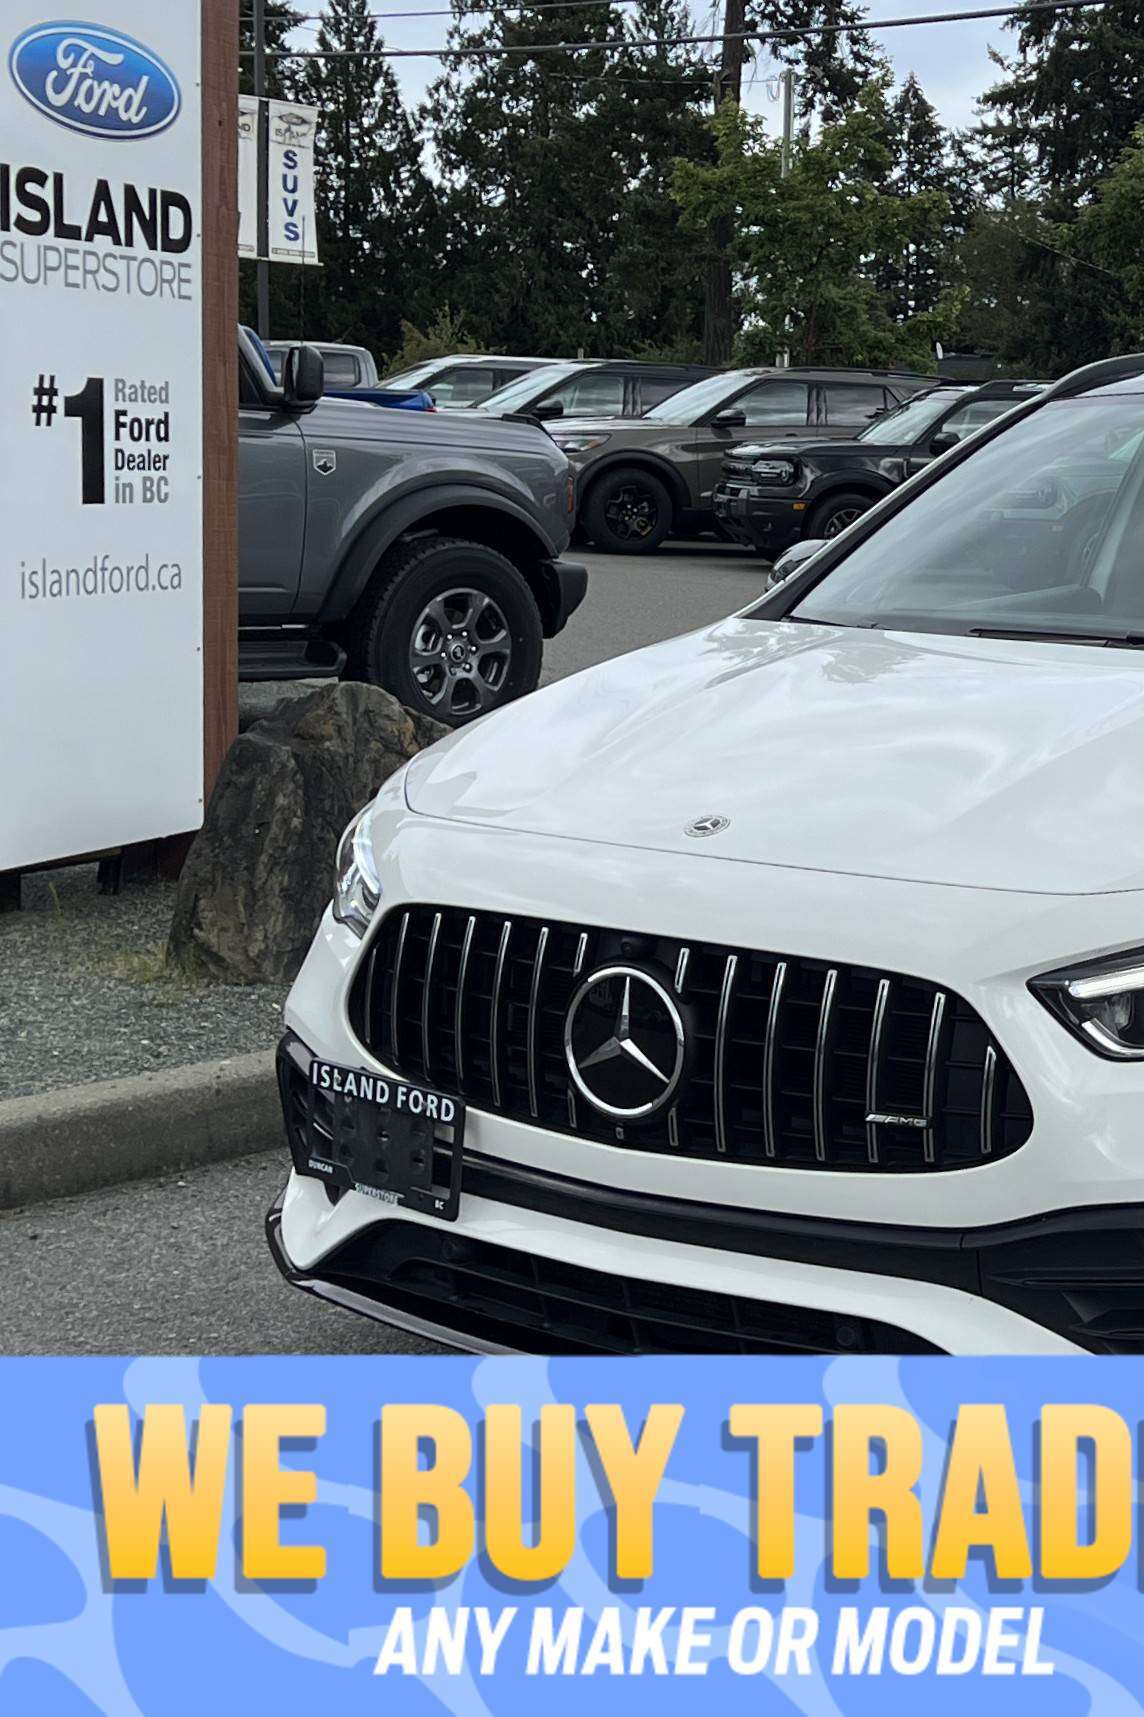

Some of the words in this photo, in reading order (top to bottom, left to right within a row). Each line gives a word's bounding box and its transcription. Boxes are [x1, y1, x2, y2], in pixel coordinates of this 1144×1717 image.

[45, 37, 149, 124] Ford
[0, 164, 193, 254] ISLAND
[281, 149, 300, 242] SUVS
[0, 240, 193, 301] SUPERSTORE
[113, 377, 170, 404] Rated
[32, 374, 106, 505] #1
[113, 409, 170, 443] Ford
[113, 448, 170, 472] Dealer
[113, 476, 134, 504] in
[142, 475, 170, 504] BC
[20, 553, 183, 600] islandford.ca
[312, 1062, 390, 1104] ISLAND
[396, 1085, 455, 1122] FORD
[884, 1115, 928, 1128] AMG
